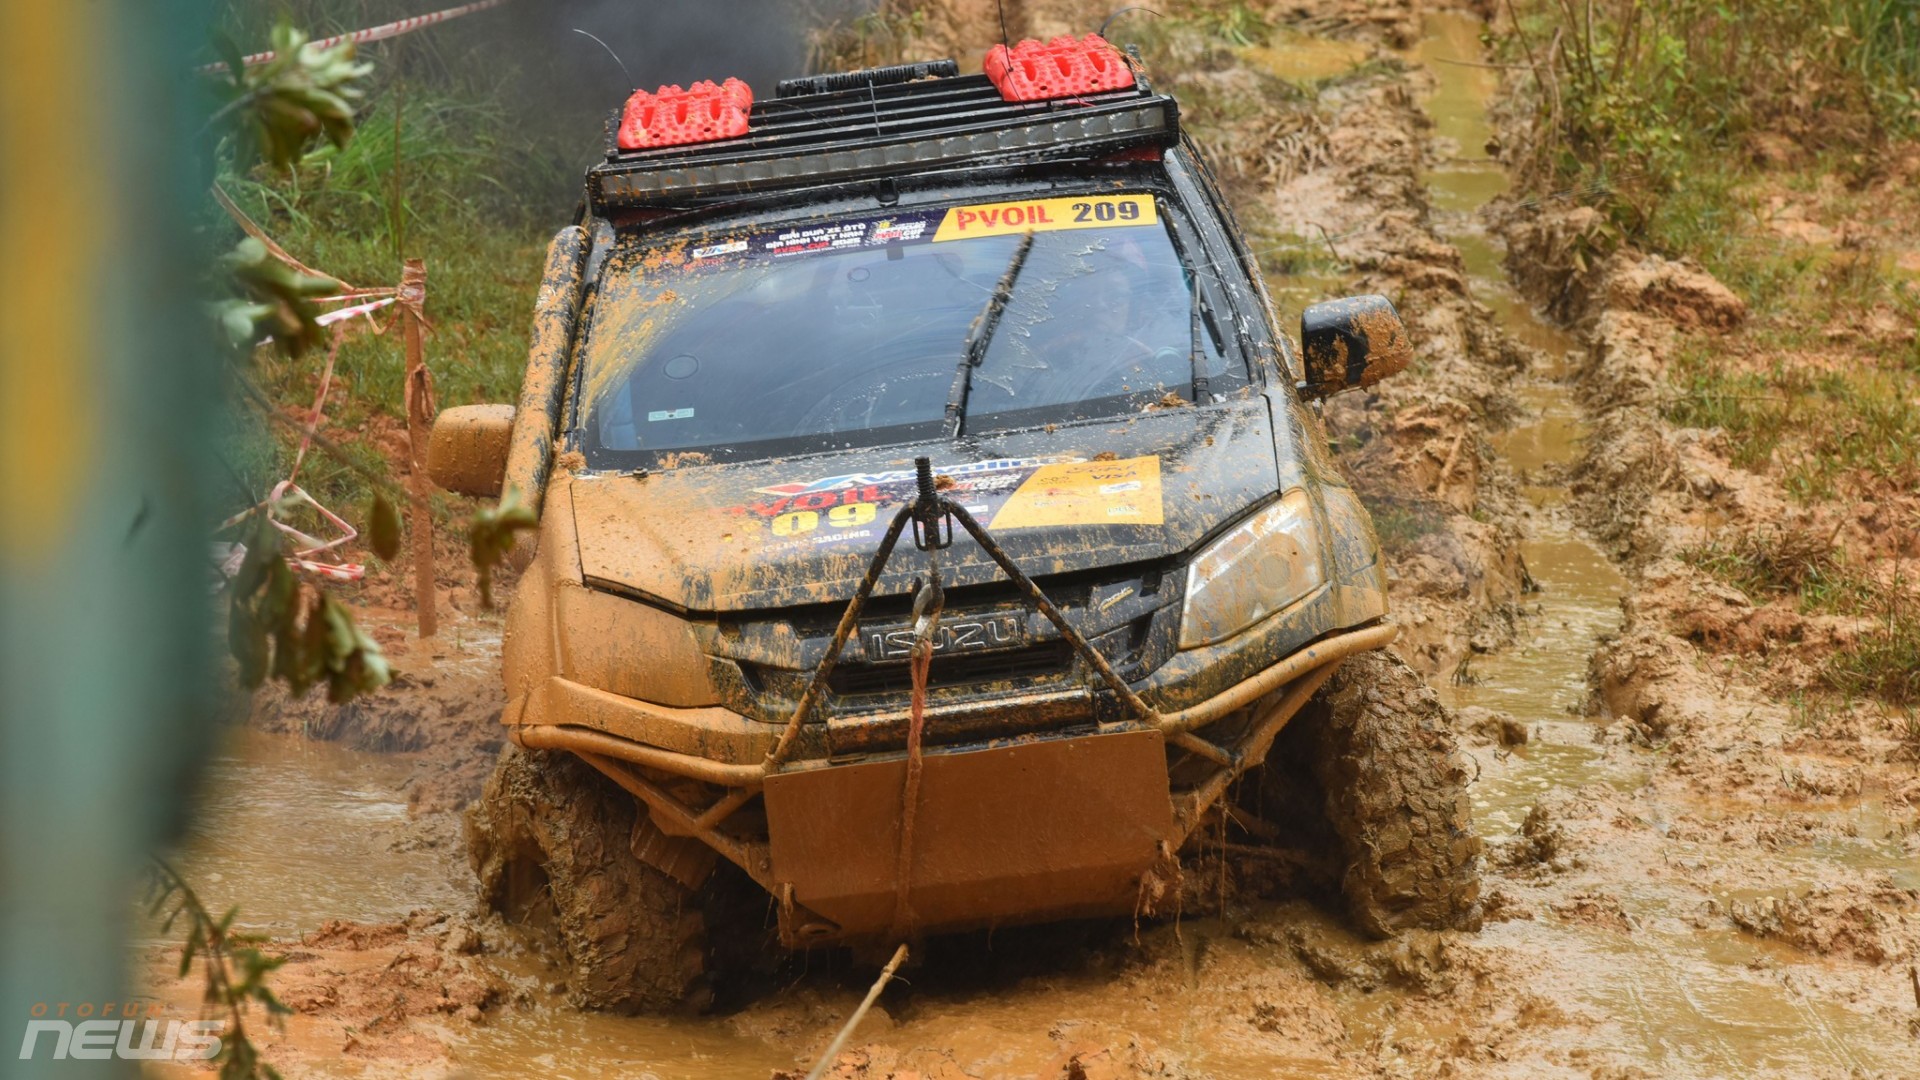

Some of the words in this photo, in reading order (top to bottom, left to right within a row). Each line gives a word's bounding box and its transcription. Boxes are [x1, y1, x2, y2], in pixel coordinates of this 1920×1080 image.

[956, 205, 1053, 231] PVOIL
[1072, 201, 1140, 223] 209
[872, 618, 1018, 659] ISUZU
